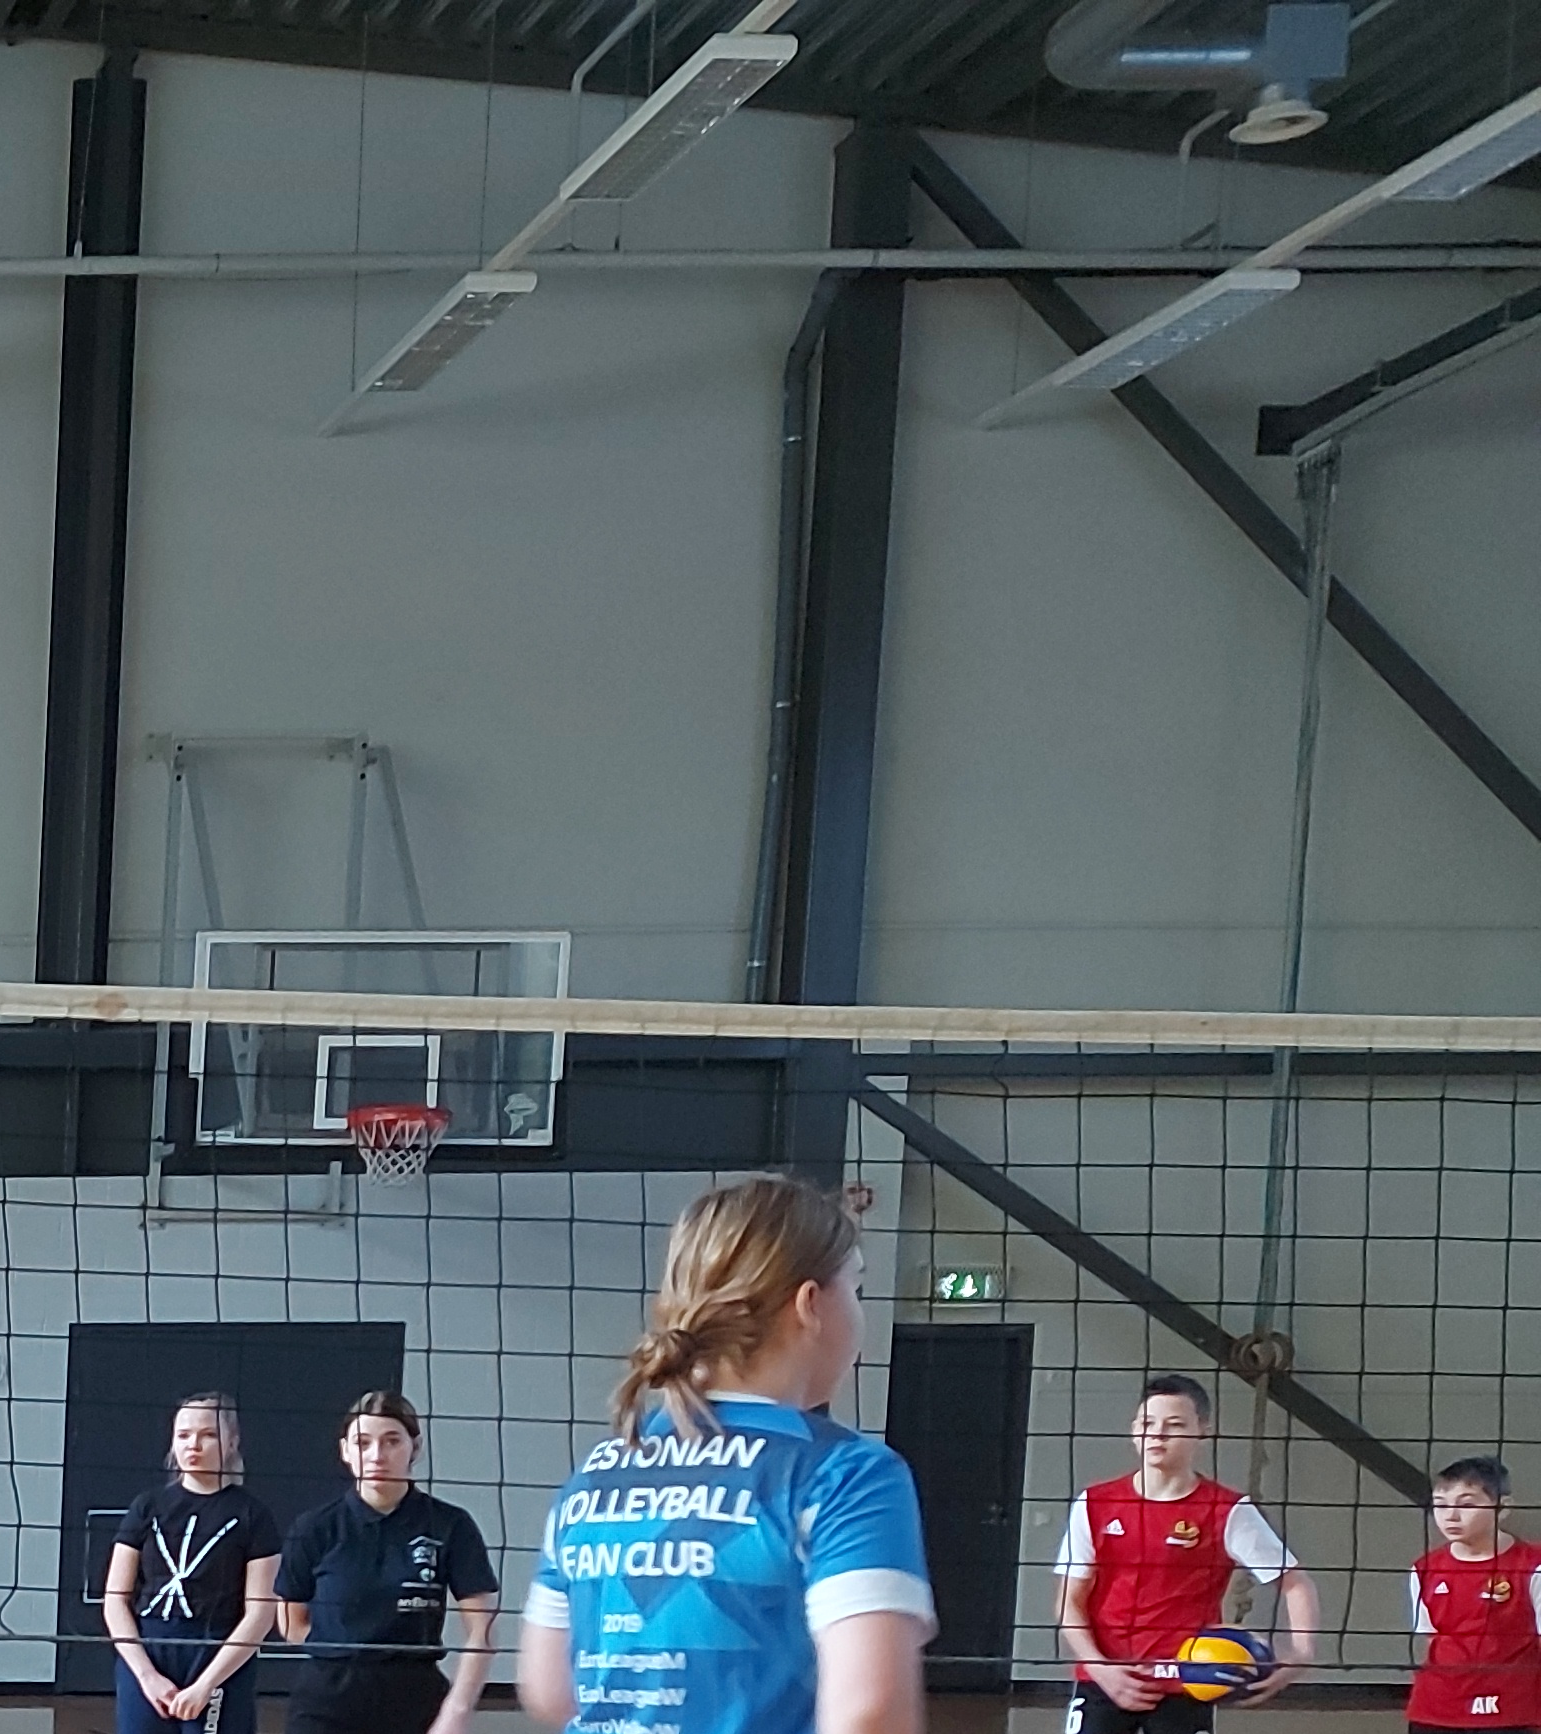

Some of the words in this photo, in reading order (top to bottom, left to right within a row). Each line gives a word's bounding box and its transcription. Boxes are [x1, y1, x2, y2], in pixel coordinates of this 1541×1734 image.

[558, 1485, 758, 1531] VOLLEYBALL
[561, 1542, 622, 1582] FAN
[624, 1540, 716, 1578] CLUB
[1470, 1695, 1500, 1715] AK
